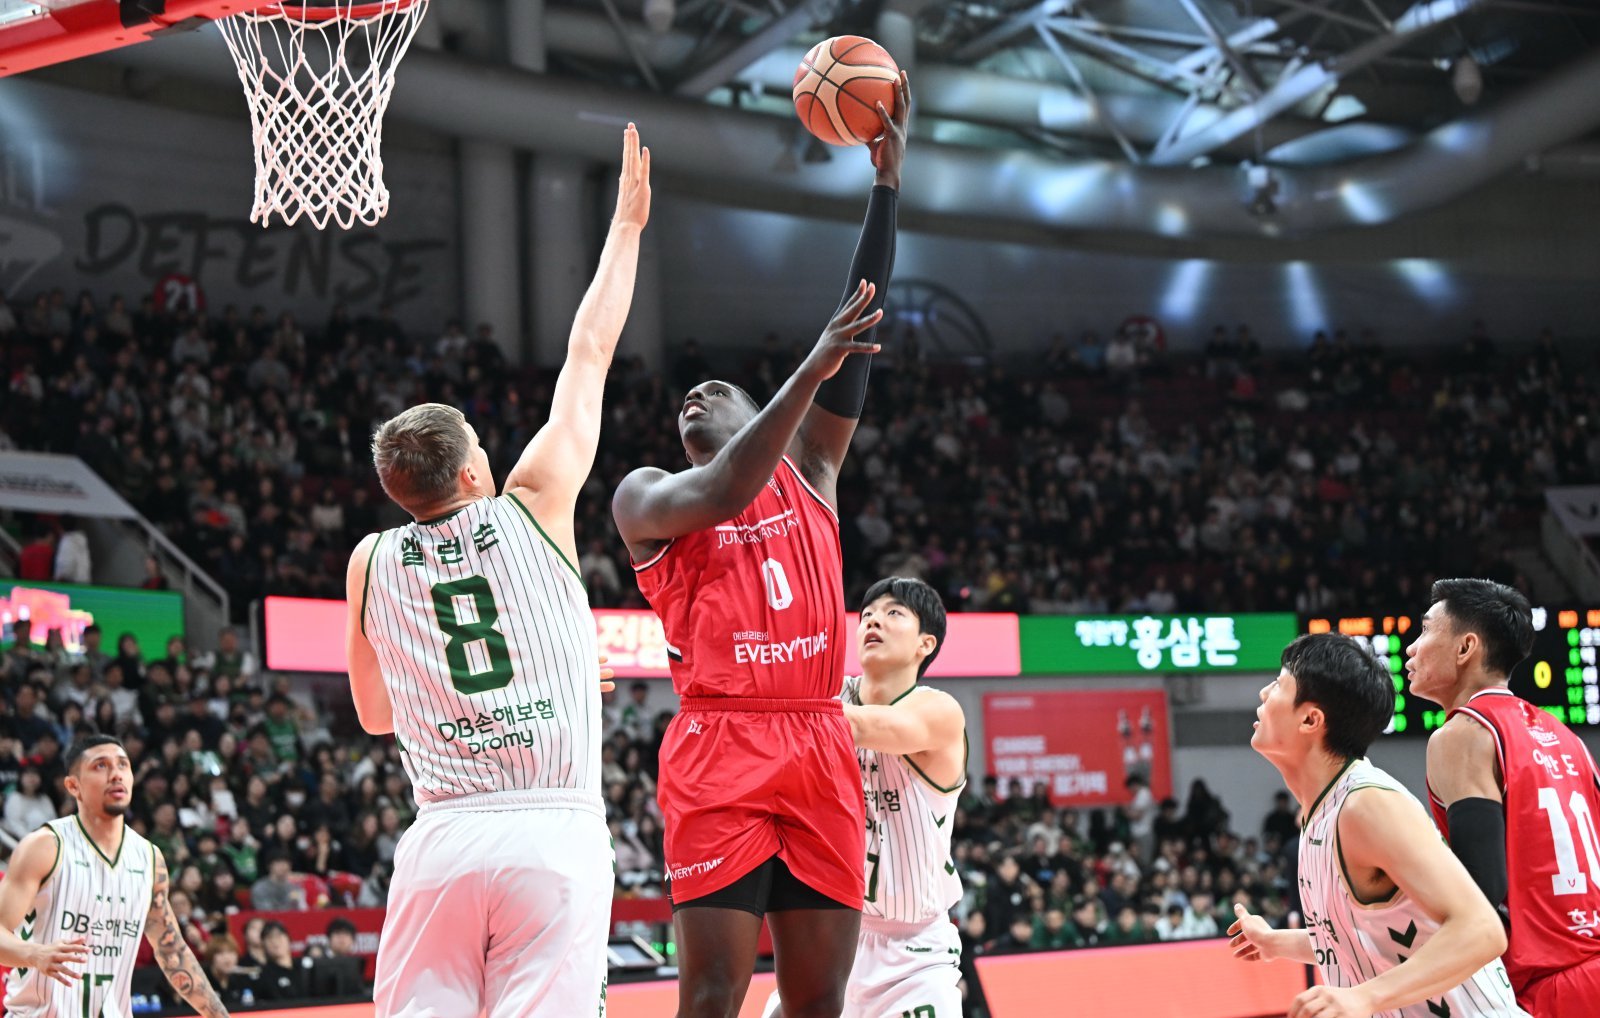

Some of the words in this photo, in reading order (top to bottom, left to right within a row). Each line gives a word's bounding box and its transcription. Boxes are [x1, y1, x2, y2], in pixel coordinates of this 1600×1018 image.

[75, 204, 448, 300] DEFENSE
[762, 558, 793, 610] 0
[431, 574, 515, 696] 8
[1534, 661, 1552, 689] 0
[438, 699, 554, 742] DB손해보험
[1538, 788, 1600, 896] 10
